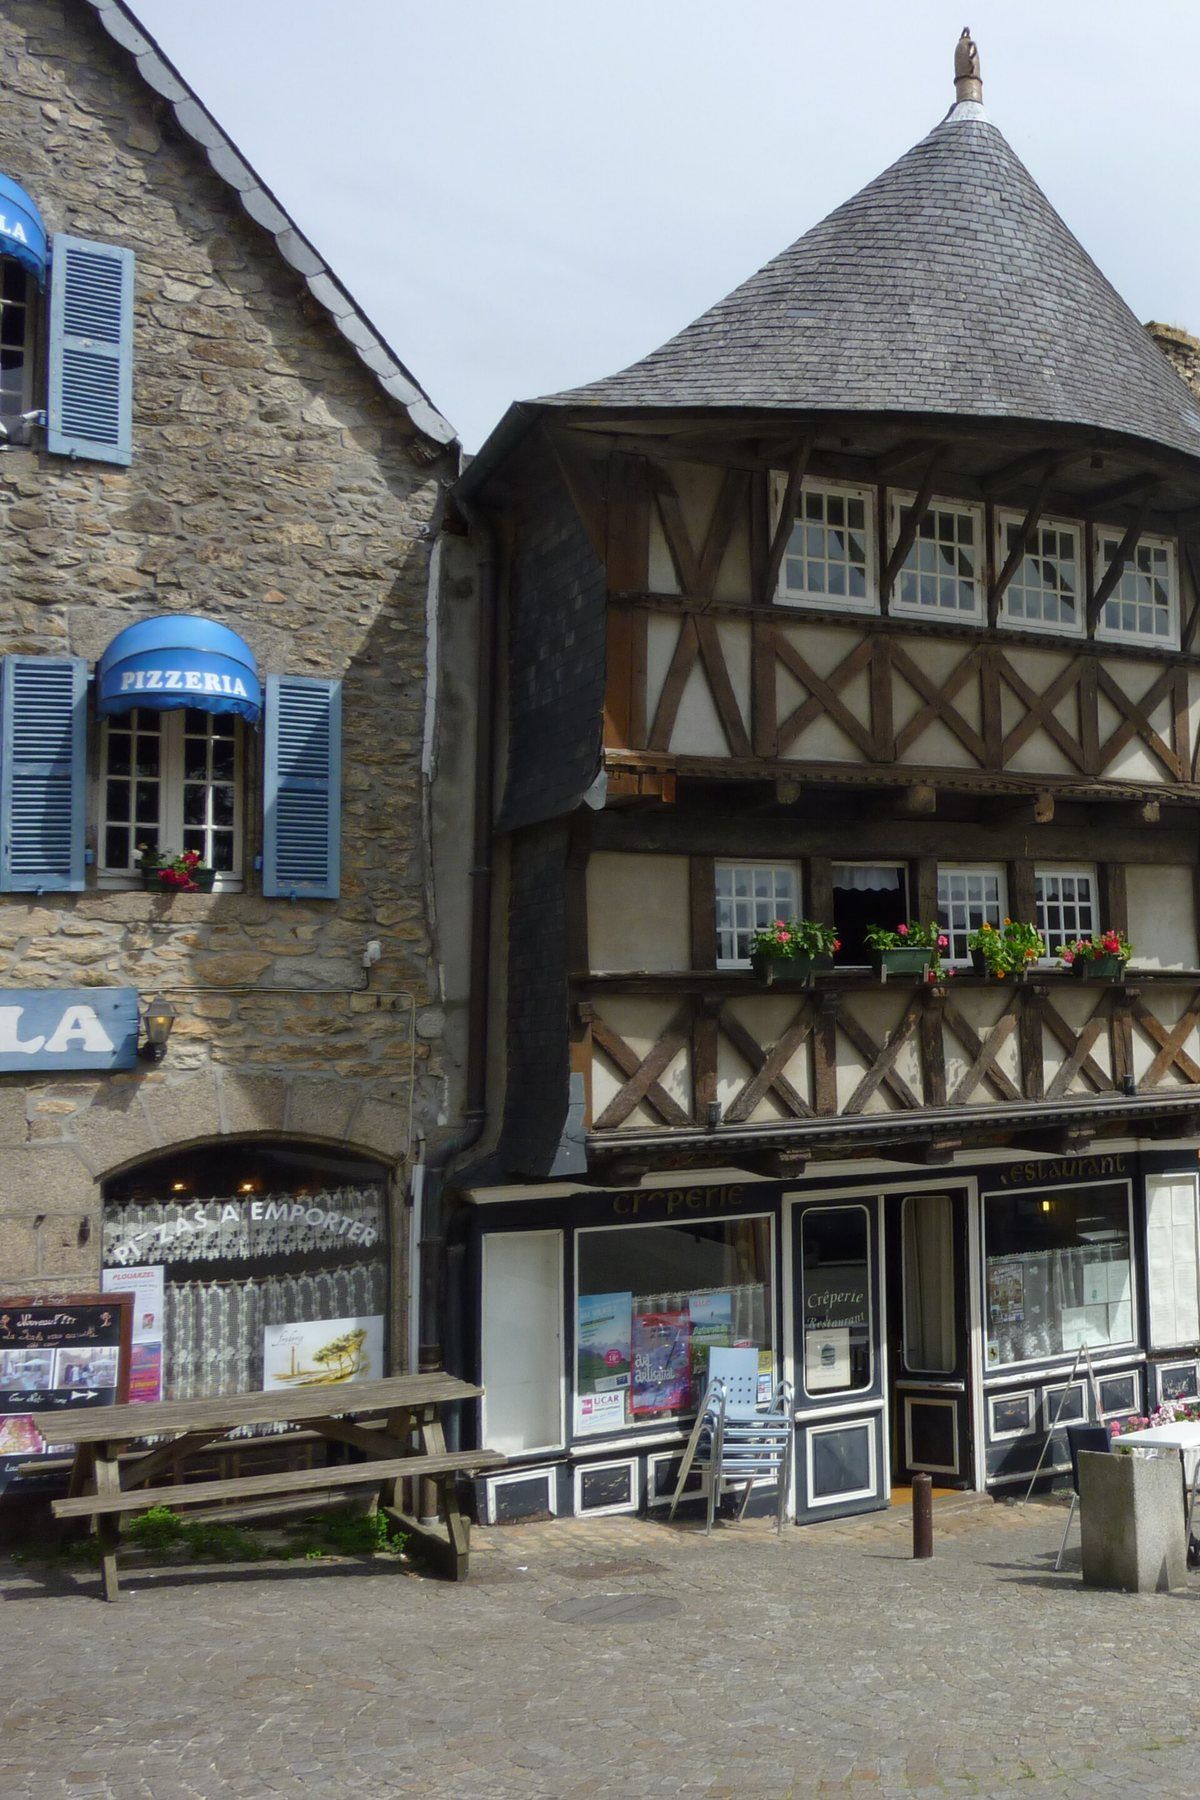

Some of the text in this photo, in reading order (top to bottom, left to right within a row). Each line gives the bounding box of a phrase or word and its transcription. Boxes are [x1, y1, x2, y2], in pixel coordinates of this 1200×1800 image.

[121, 671, 247, 697] PIZZERIA
[1001, 1153, 1126, 1185] estaurant
[113, 1202, 378, 1265] PIZAS A EMPORTER
[807, 1288, 864, 1309] Crêperie
[807, 1311, 865, 1329] Restaurant
[593, 1394, 620, 1406] UCAR
